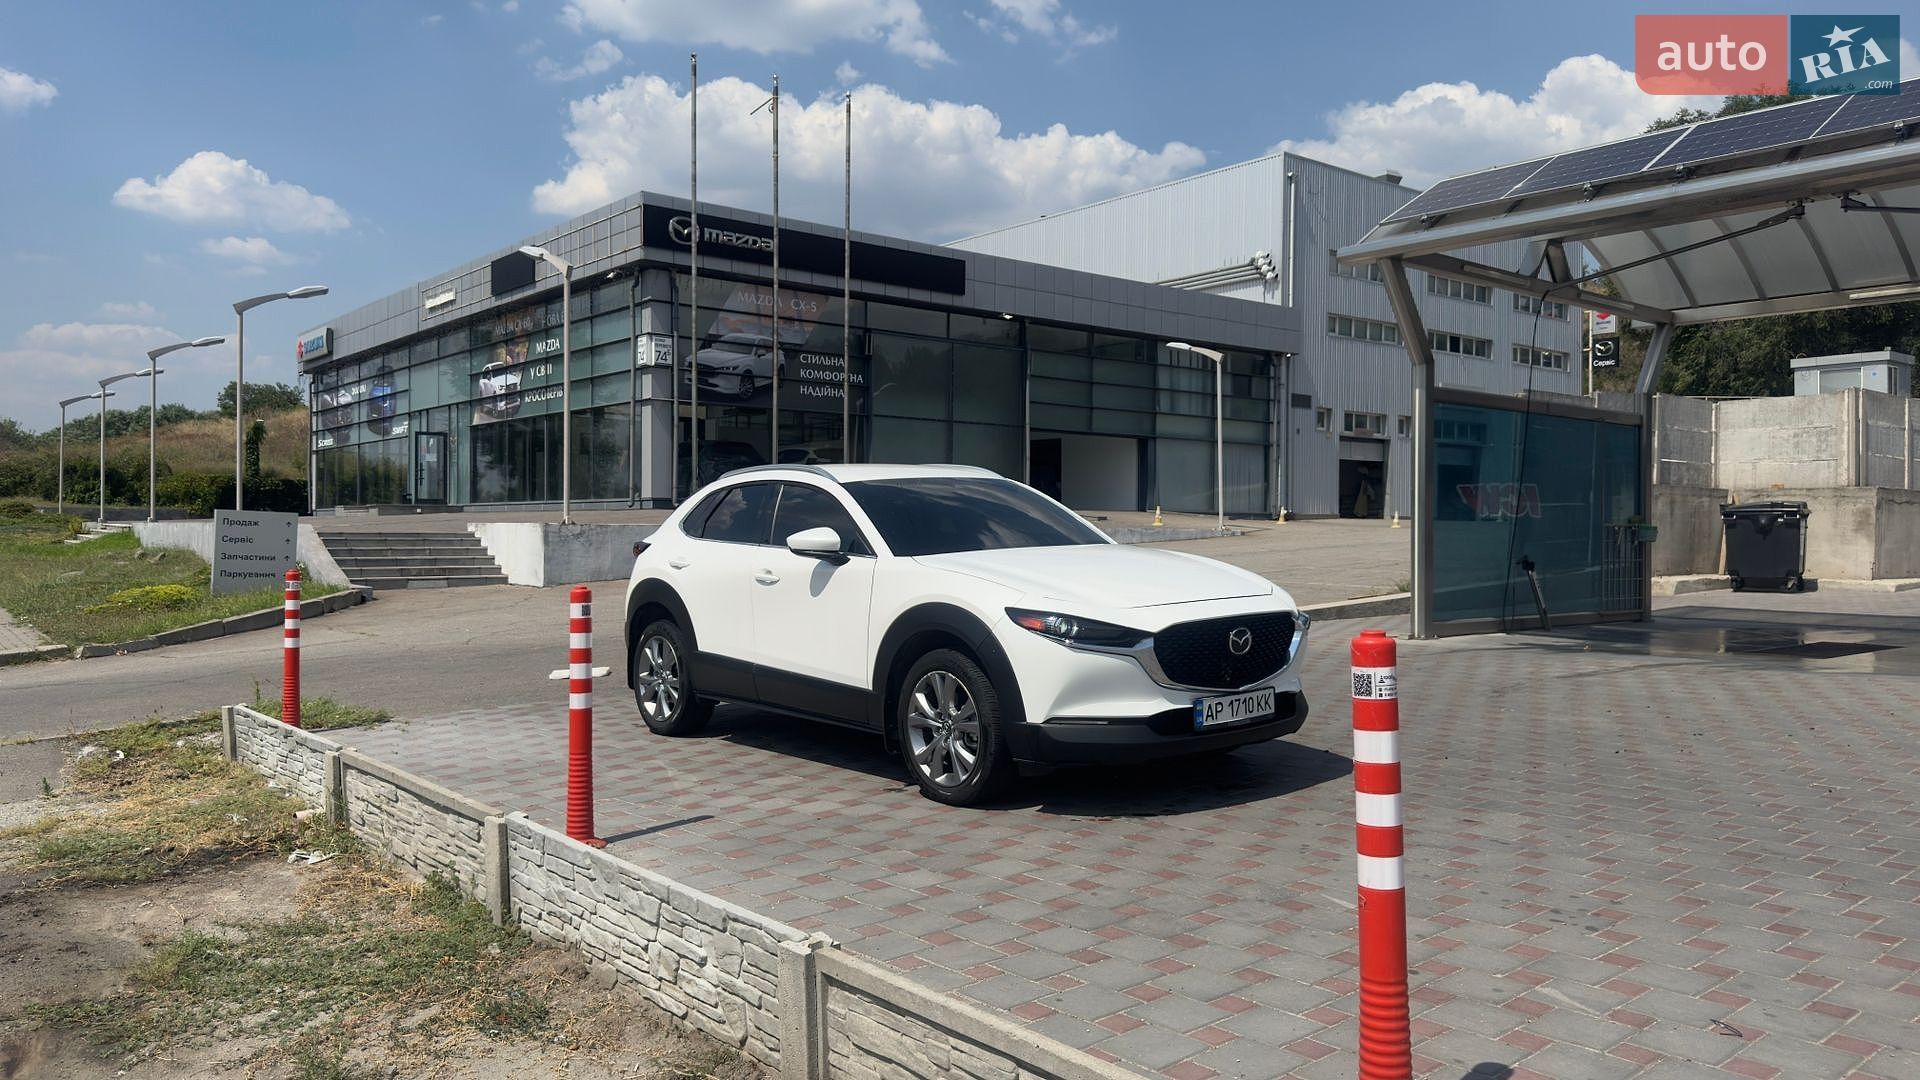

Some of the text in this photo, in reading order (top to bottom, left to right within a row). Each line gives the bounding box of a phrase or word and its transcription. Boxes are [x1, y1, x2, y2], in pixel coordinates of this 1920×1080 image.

[800, 352, 846, 367] СТИЛЬНА
[800, 368, 864, 384] КОМФОРНА
[800, 383, 846, 398] НАДІЙНА
[222, 517, 260, 527] Продаж
[221, 535, 254, 544] Сервіс
[220, 552, 276, 561] Запчастини
[1205, 692, 1272, 722] AP 1710 KK
